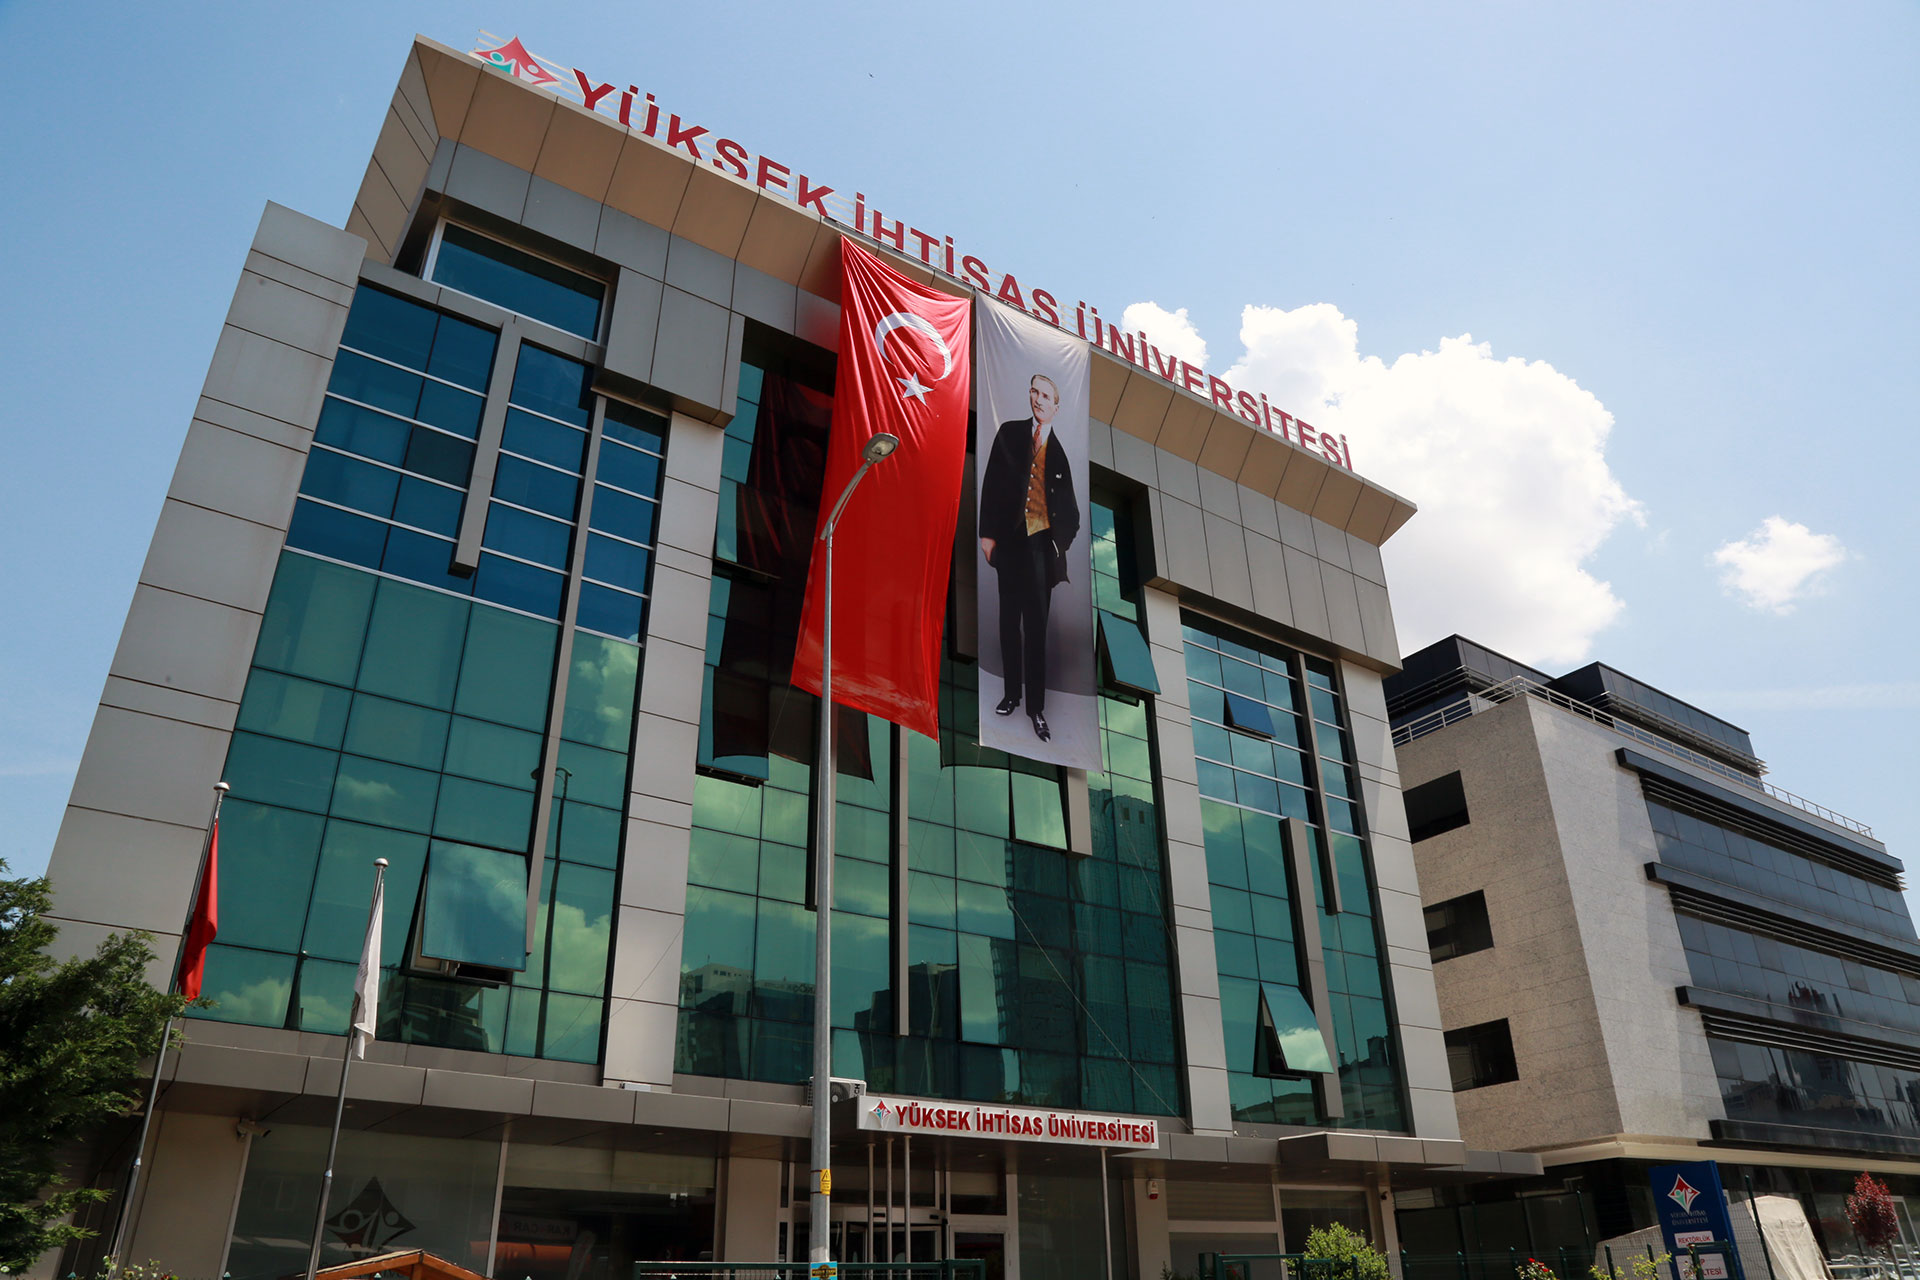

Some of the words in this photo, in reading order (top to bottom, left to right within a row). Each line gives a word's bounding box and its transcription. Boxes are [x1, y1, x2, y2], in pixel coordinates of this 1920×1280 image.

[572, 68, 835, 216] YÜKSEK
[855, 192, 1060, 327] İHTİSAS
[1076, 300, 1353, 472] ÜNİVERSİTESİ
[895, 1102, 971, 1131] YÜKSEK
[976, 1107, 1043, 1135] İHTİSAS
[1048, 1114, 1155, 1143] ÜNİVERSİTESİ
